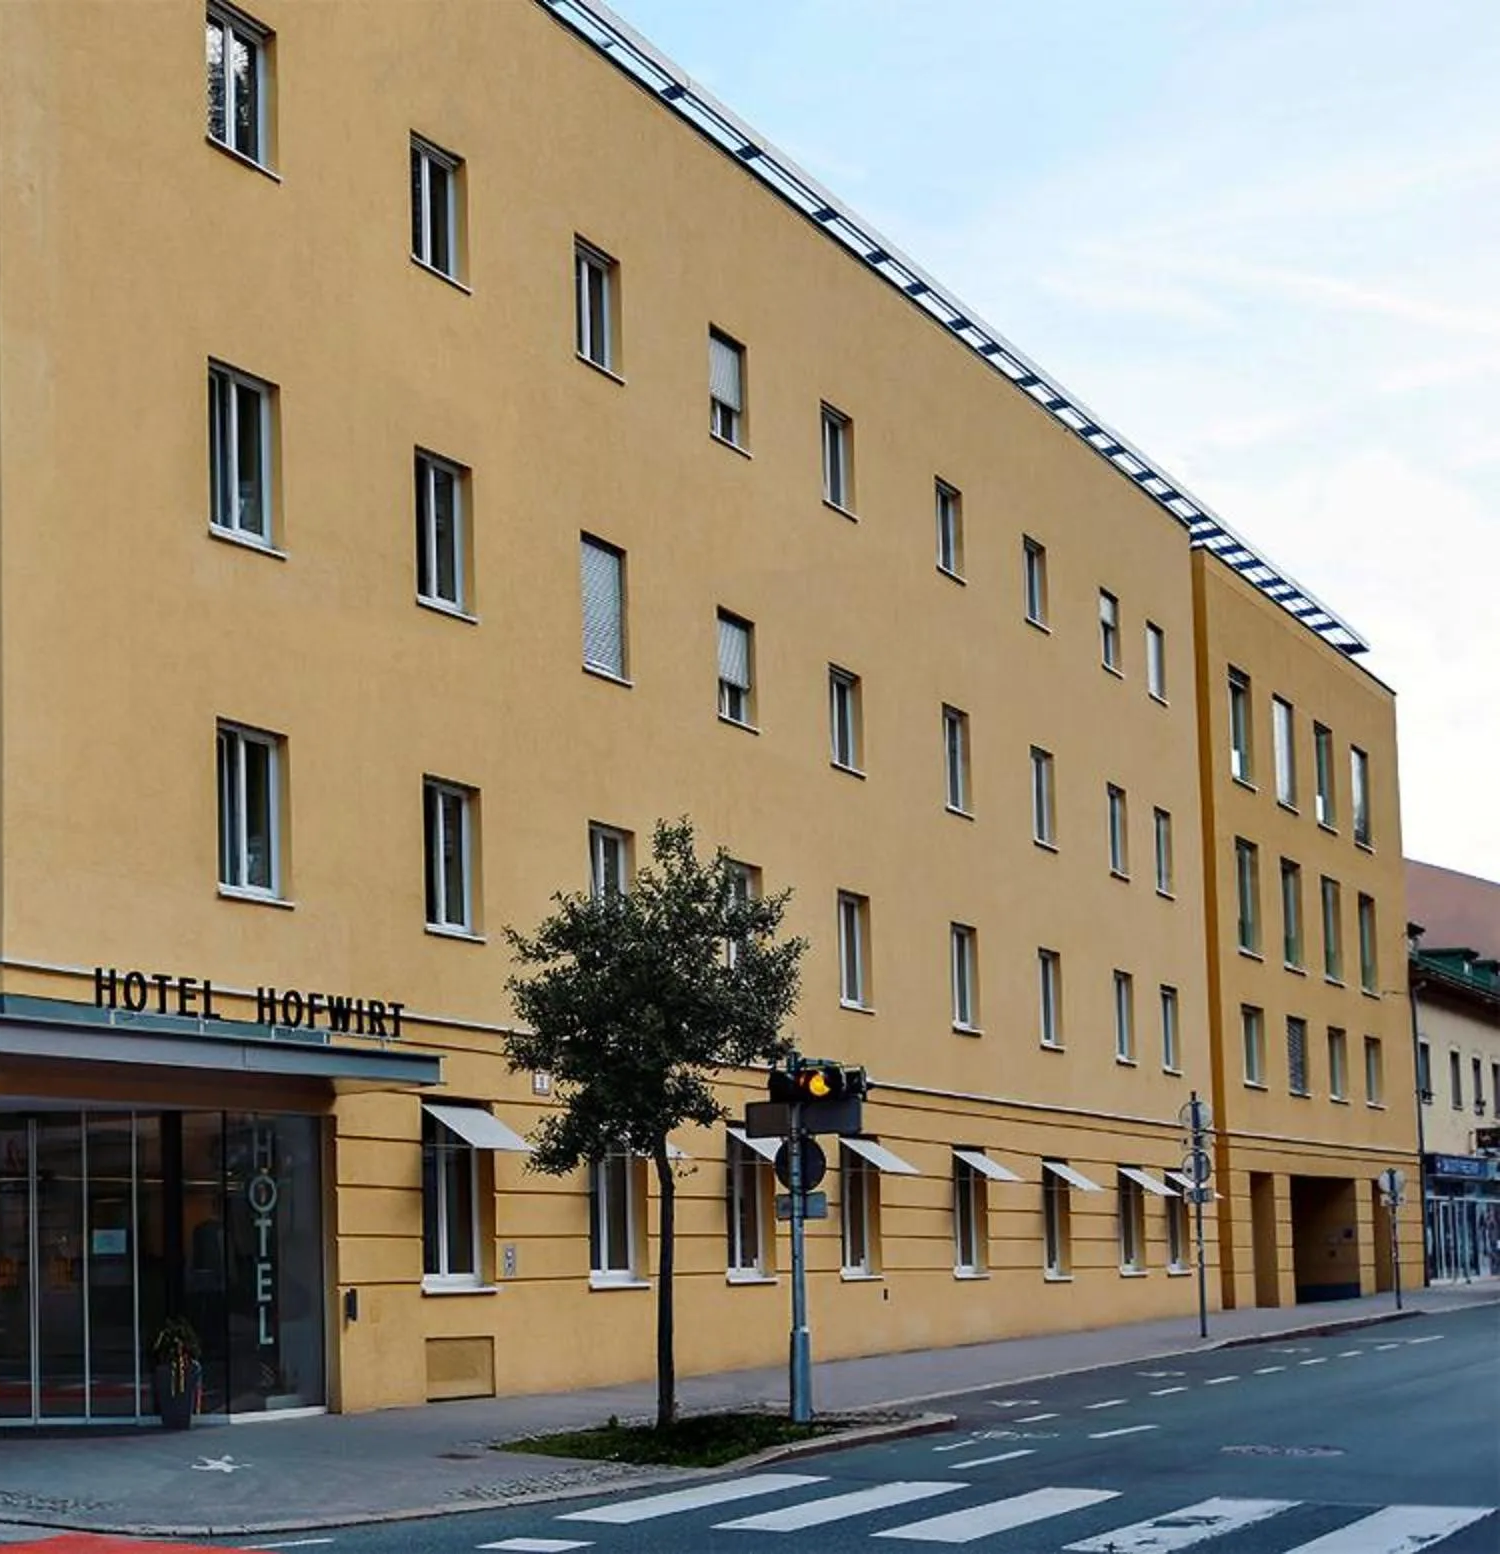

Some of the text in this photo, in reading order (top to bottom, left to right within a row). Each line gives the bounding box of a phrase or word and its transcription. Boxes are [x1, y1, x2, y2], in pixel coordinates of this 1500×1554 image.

[95, 967, 405, 1037] HOTEL HOFWIRT
[248, 1128, 278, 1345] HOTEL
